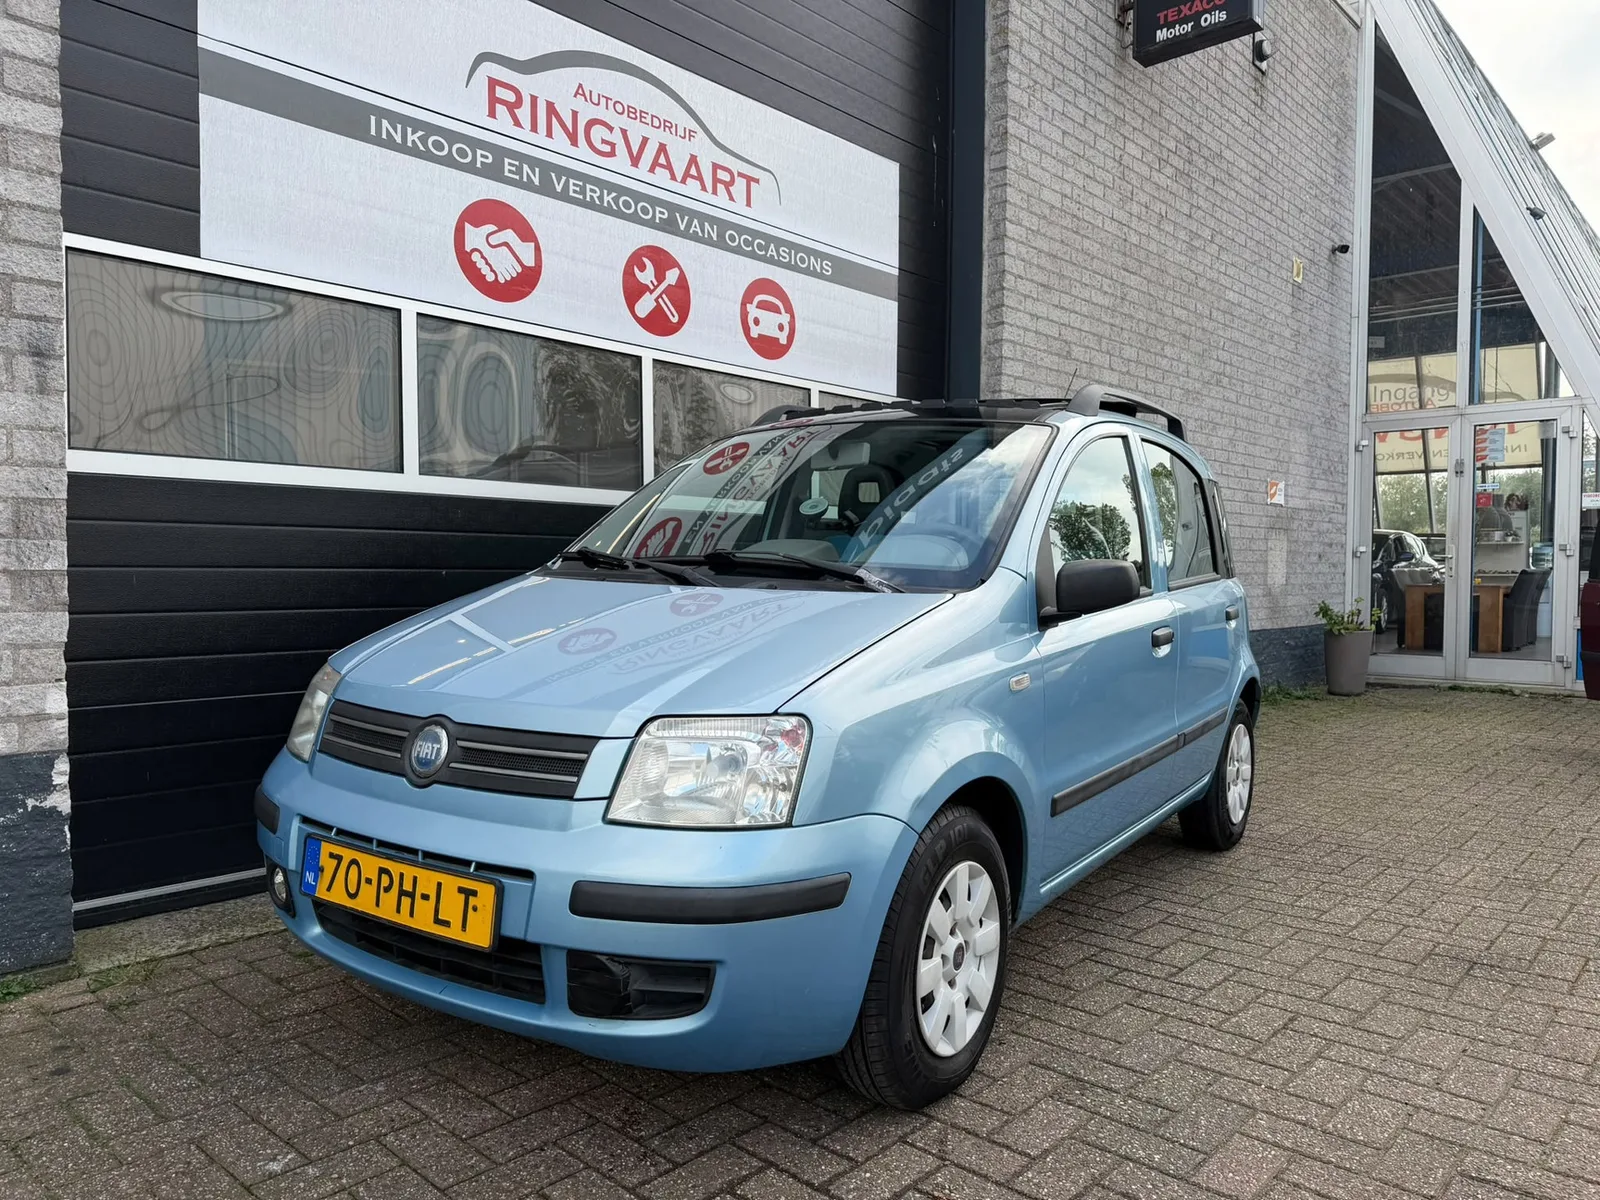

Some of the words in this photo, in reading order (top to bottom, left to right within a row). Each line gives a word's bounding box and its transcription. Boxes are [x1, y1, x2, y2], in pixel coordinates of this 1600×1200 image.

[1156, 20, 1194, 43] Motor
[1200, 9, 1227, 28] Oils
[572, 82, 698, 143] AUTOBEDRIJF
[486, 75, 760, 209] RINGVAART
[369, 114, 493, 169] INKOOP
[503, 160, 540, 187] EN
[550, 172, 669, 225] VERKOOP
[676, 212, 718, 242] VAN
[725, 230, 833, 276] OCCASIONS
[1374, 385, 1450, 402] Ingang
[414, 741, 441, 761] FIAT
[305, 870, 317, 886] NL
[325, 851, 479, 933] 70-PH-LT
